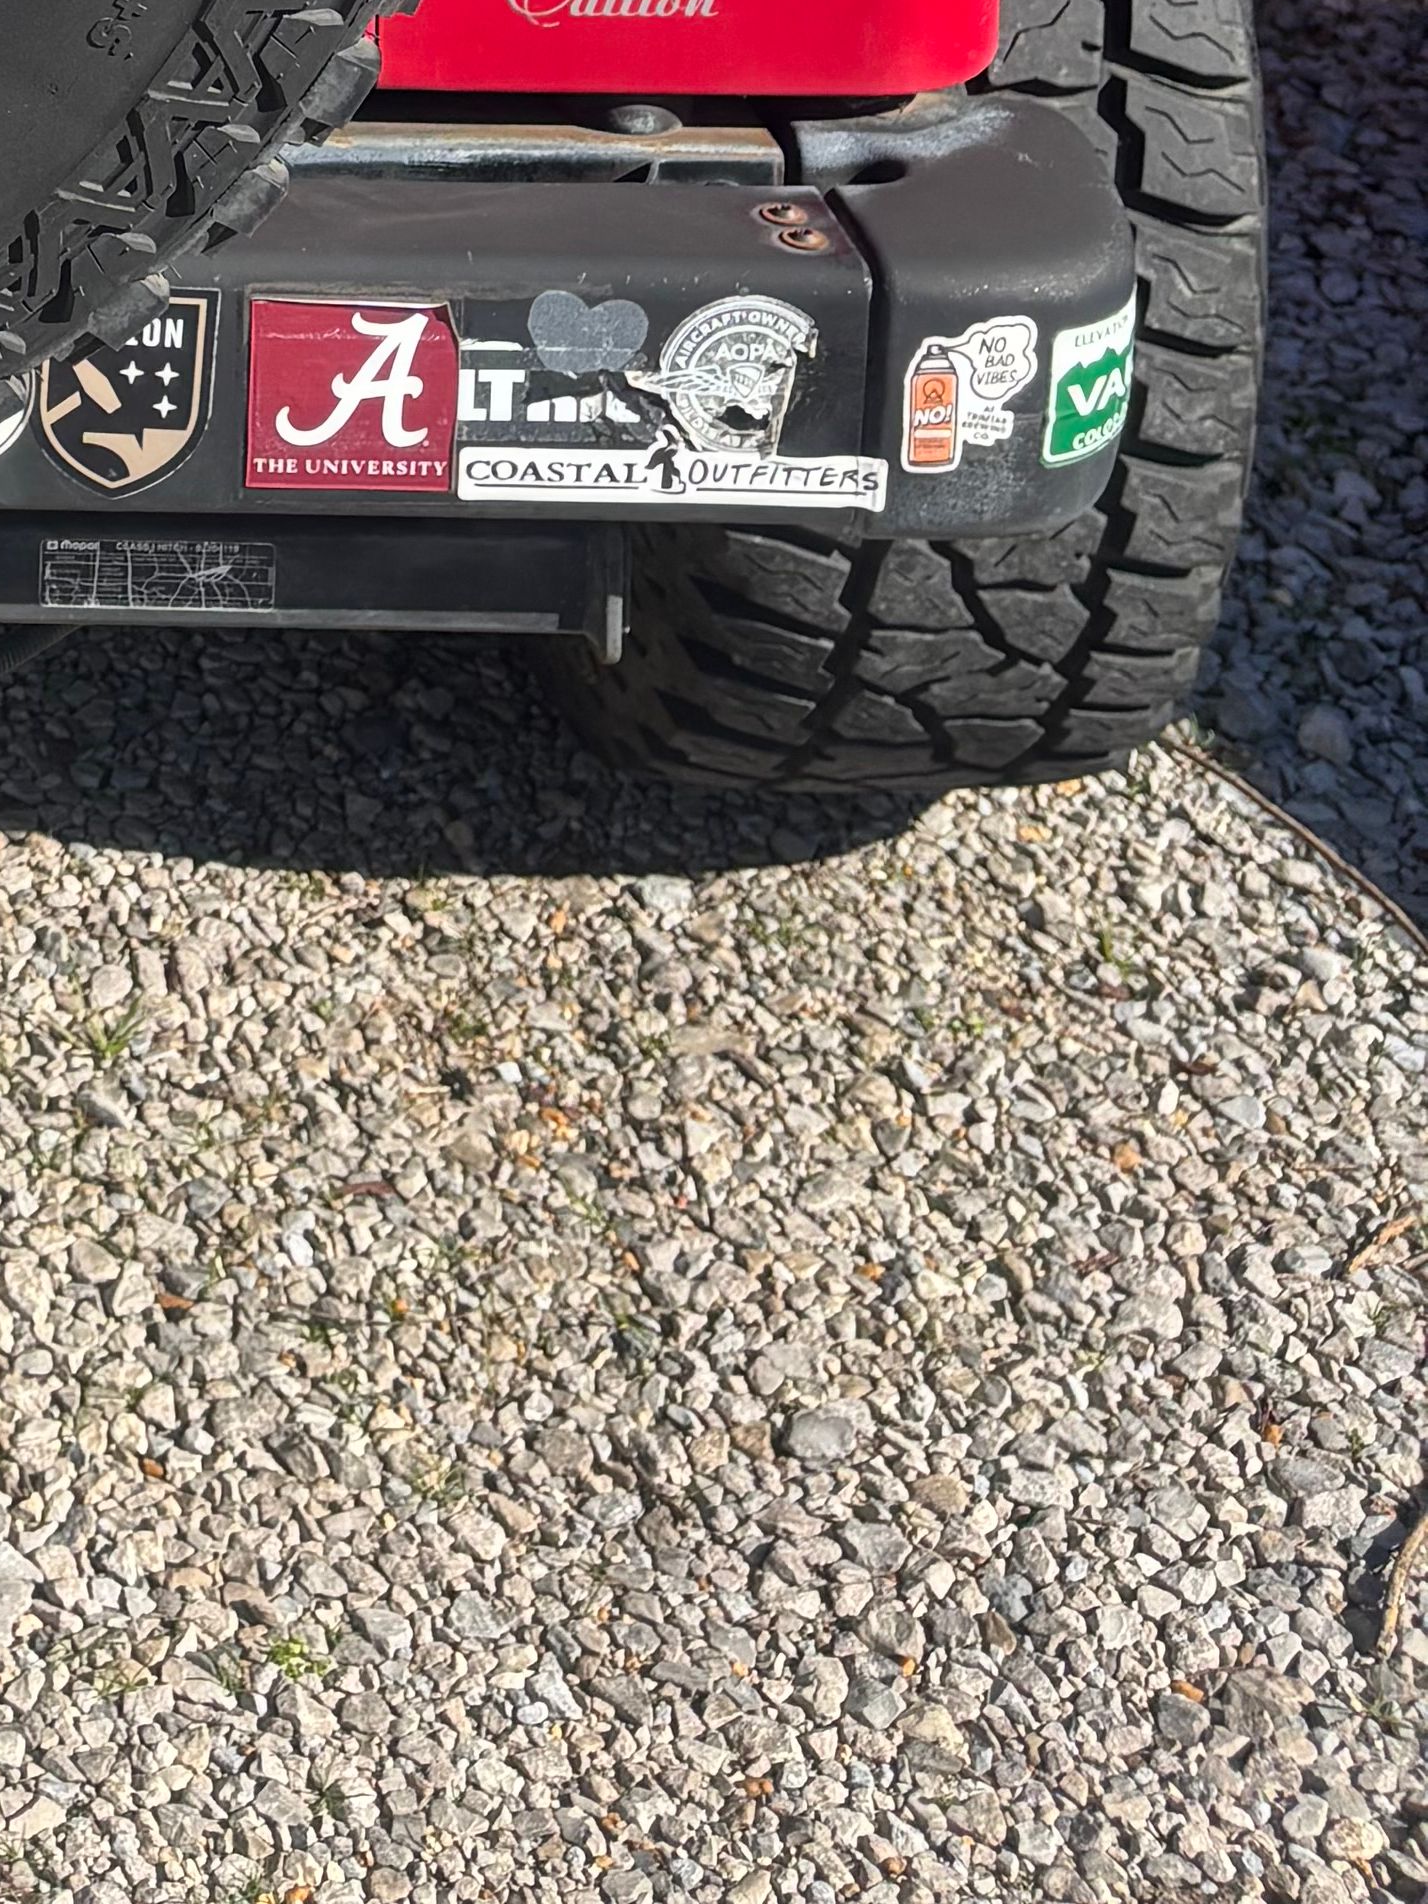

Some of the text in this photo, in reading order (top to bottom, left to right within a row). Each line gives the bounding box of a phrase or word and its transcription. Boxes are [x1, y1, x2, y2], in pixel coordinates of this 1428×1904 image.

[714, 340, 777, 363] AOPA
[978, 336, 1007, 356] NO
[984, 353, 1015, 369] BAD
[977, 369, 1017, 386] VIBES
[913, 404, 954, 427] NO!
[253, 457, 448, 477] THE UNIVERSITY
[465, 458, 880, 492] COASTAL OUTFITTERS
